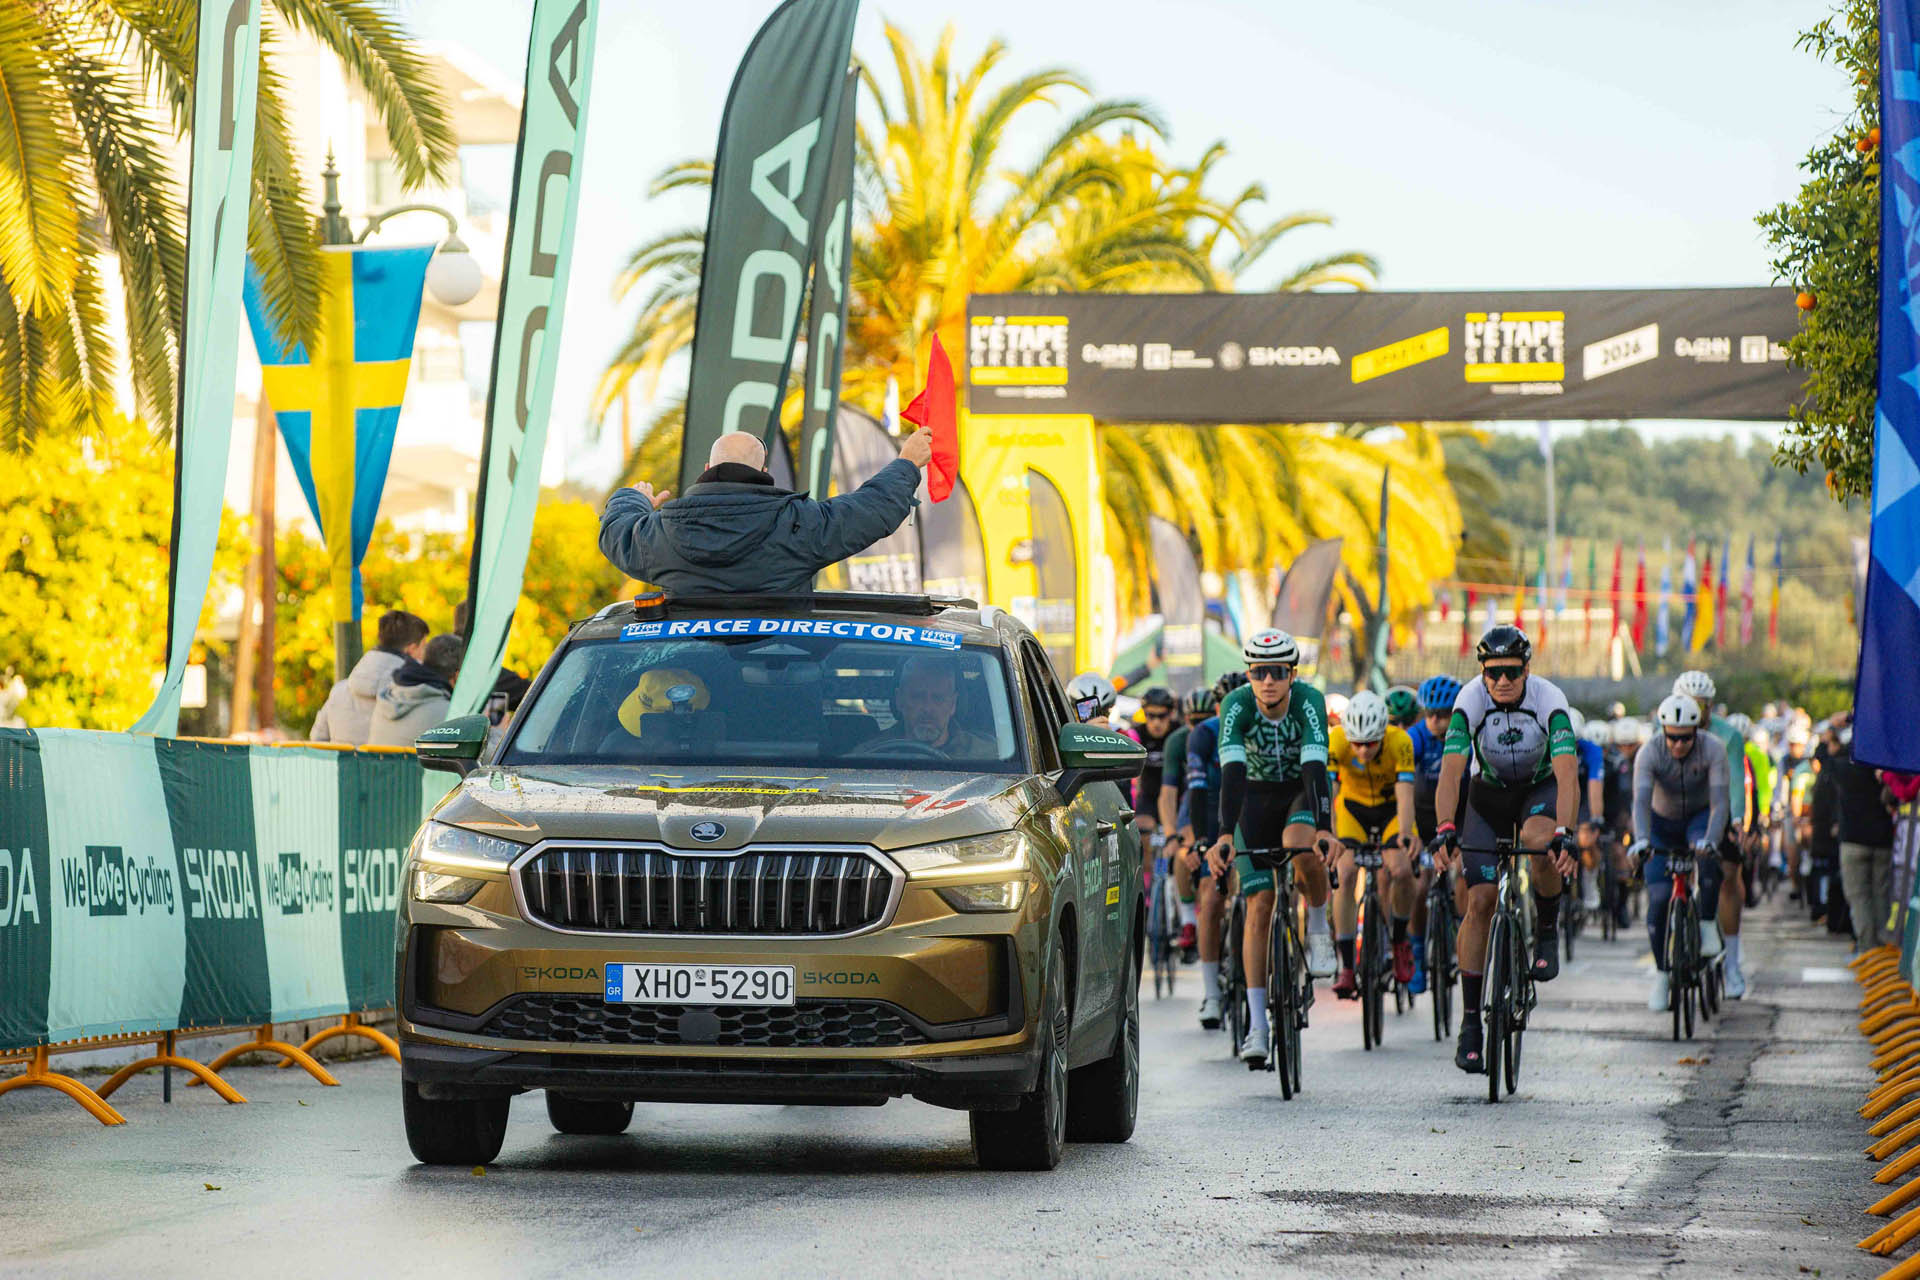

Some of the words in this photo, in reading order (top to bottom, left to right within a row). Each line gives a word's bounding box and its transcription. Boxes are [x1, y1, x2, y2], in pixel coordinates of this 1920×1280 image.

[668, 620, 751, 635] RACE
[758, 620, 915, 642] DIRECTOR
[1221, 702, 1243, 745] SKODA
[1073, 735, 1128, 746] SKODA
[61, 857, 86, 908] We
[88, 850, 124, 907] Love
[127, 855, 174, 915] Cycling
[184, 848, 258, 919] SKODA
[264, 861, 280, 905] We
[303, 860, 333, 913] Cycling
[344, 848, 408, 914] SKOD
[524, 967, 600, 980] SKODA
[803, 972, 881, 985] SKODA
[607, 986, 621, 996] GR
